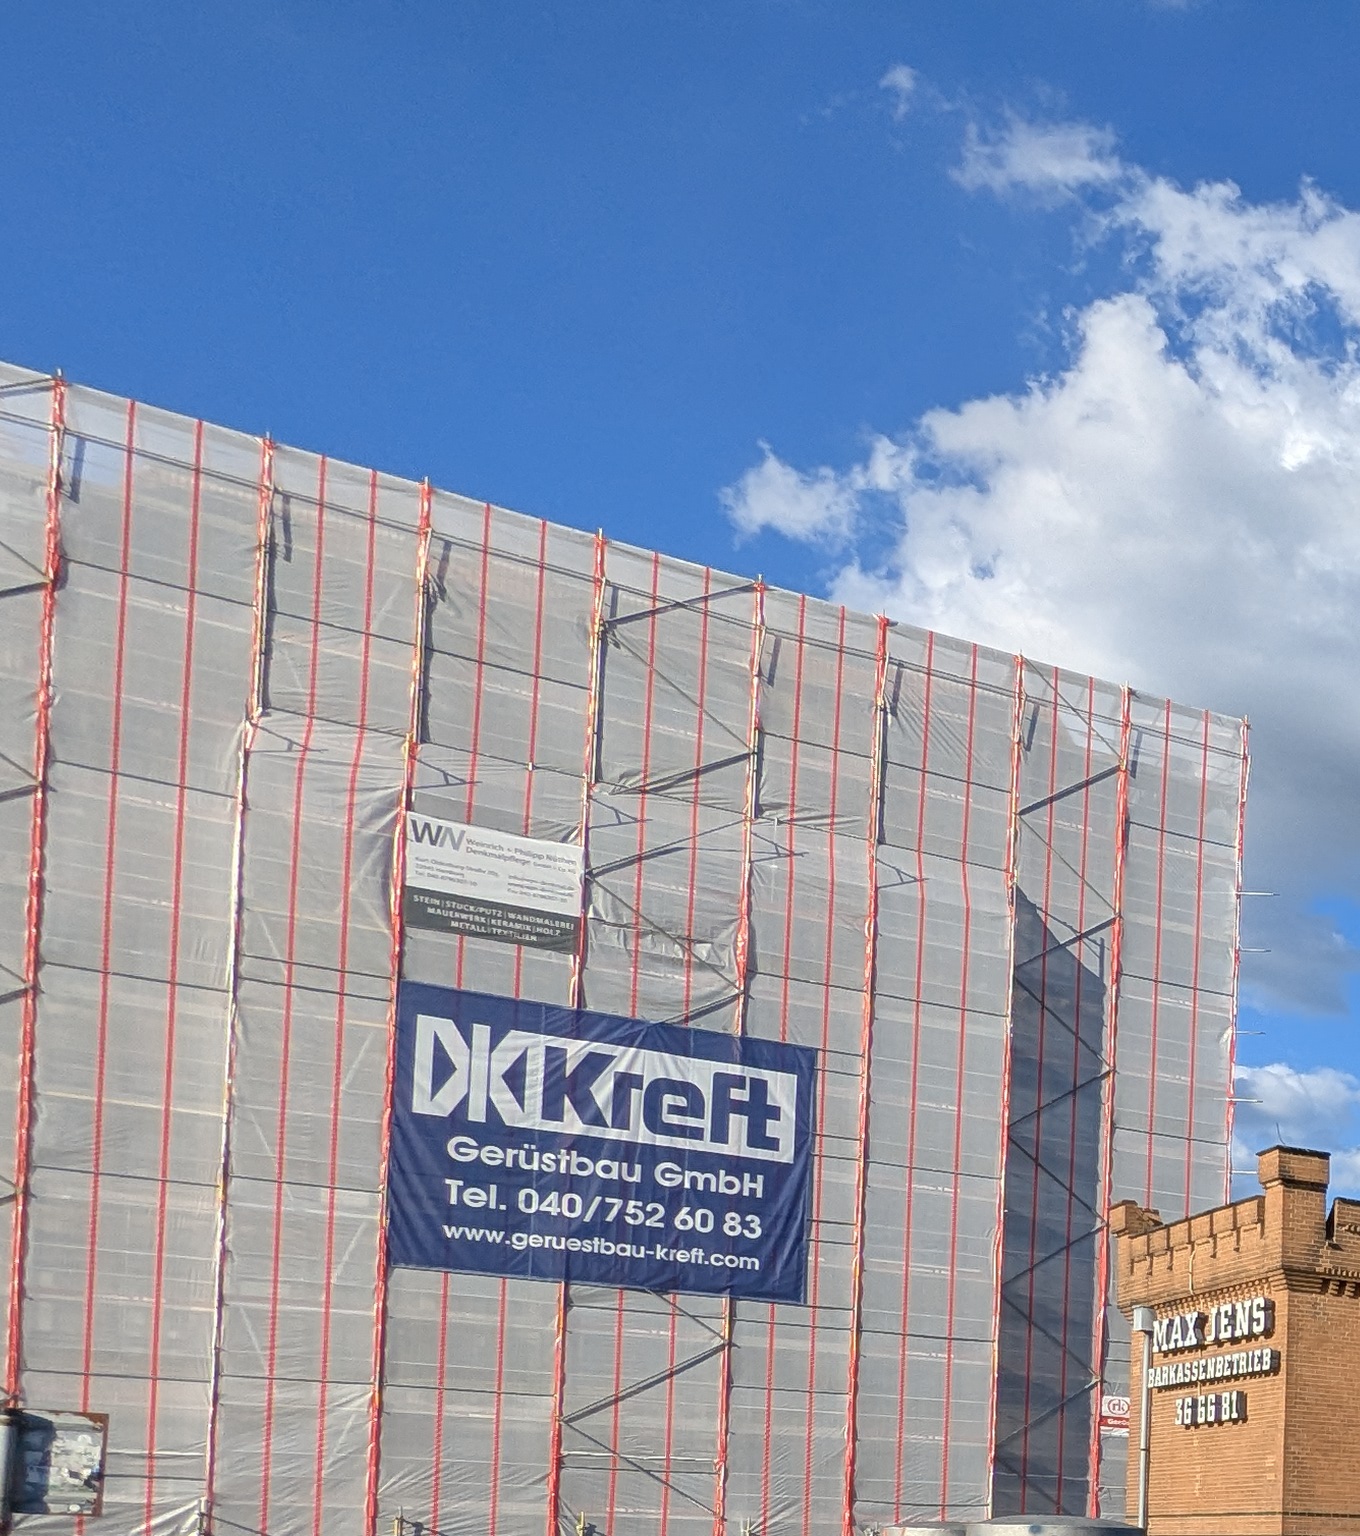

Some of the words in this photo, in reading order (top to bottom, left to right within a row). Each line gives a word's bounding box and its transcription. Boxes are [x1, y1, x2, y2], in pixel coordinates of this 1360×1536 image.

[446, 1135, 642, 1183] Gerüstbau
[653, 1161, 764, 1198] GmbH
[444, 1178, 506, 1211] Tel.
[517, 1188, 665, 1229] 040/752
[673, 1207, 715, 1234] 60
[722, 1212, 763, 1239] 83
[442, 1224, 761, 1271] www.geruestbau-kreft.com
[1152, 1311, 1199, 1353] MAX
[1205, 1296, 1265, 1342] JENS
[1147, 1347, 1272, 1388] BARKASSENBETRIEB
[1174, 1397, 1192, 1425] 36
[1221, 1390, 1239, 1422] 81
